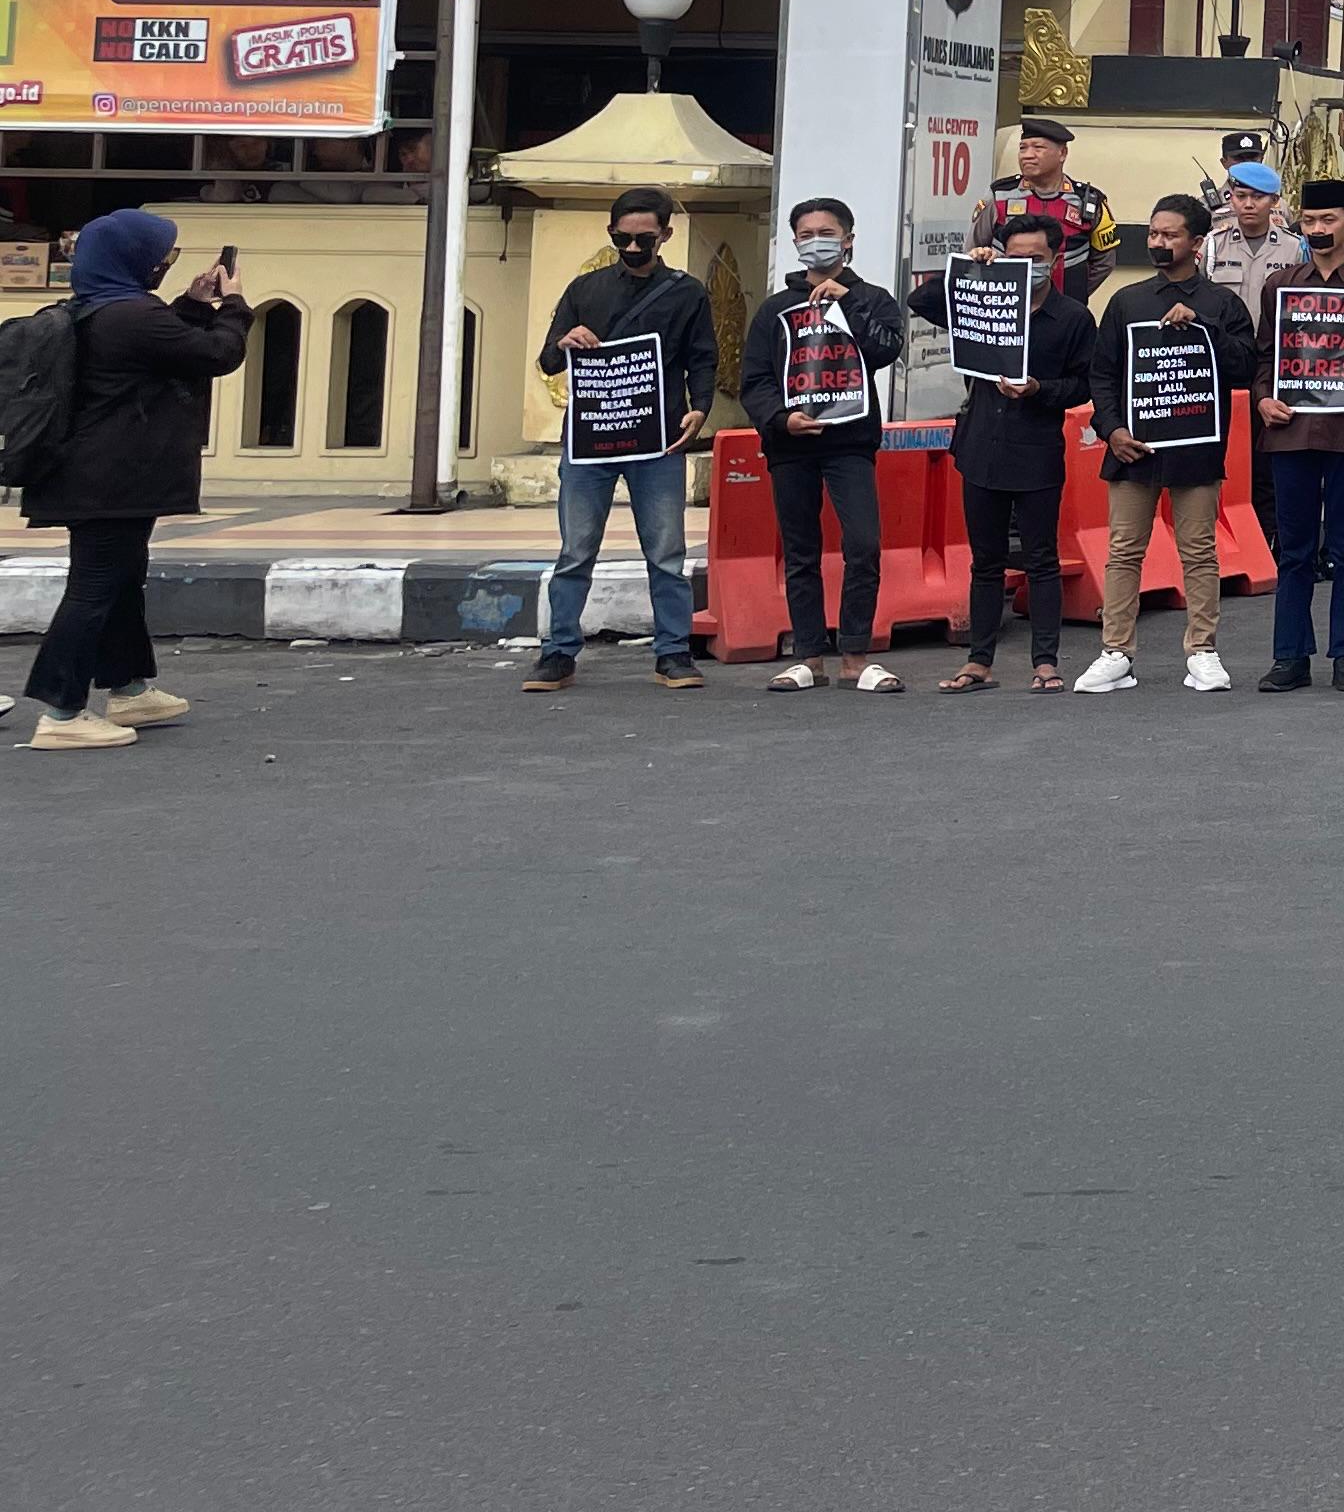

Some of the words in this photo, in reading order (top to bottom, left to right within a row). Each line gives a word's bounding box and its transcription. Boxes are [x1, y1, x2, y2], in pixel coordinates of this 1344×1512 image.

[100, 20, 132, 37] NO
[141, 21, 190, 38] KKN
[100, 42, 132, 59] NO
[139, 42, 199, 60] CALO
[242, 35, 346, 69] GRATIS
[923, 36, 948, 65] POLRES
[949, 41, 994, 71] LUMAJANG
[121, 98, 343, 117] @penerimaanpoldajatim
[928, 116, 944, 134] CALL
[945, 119, 979, 138] CENTER
[932, 140, 970, 197] 110
[956, 278, 987, 291] HITAM
[988, 281, 1017, 292] BAJU
[983, 295, 1019, 306] GELAP
[956, 304, 1017, 319] PENEGAKAN
[1292, 312, 1312, 322] BISA
[1314, 313, 1321, 322] 4
[958, 317, 990, 331] HUKUM
[992, 321, 1016, 332] BBM
[952, 328, 985, 343] SUBSIDI
[987, 334, 996, 345] DI
[791, 344, 857, 365] KENAPA
[1138, 348, 1150, 357] 03
[1152, 345, 1205, 357] NOVEMBER
[1157, 359, 1186, 369] 2025:
[788, 368, 862, 391] POLRES
[1134, 372, 1167, 382] SUDAH
[1169, 371, 1176, 380] 3
[1177, 368, 1211, 380] BULAN
[1158, 383, 1186, 393] LALU,
[1305, 380, 1321, 390] 100
[812, 393, 830, 403] 100
[1132, 397, 1152, 407] TAPI
[1154, 392, 1214, 406] TERSANGKA
[1139, 408, 1171, 419] MASIH
[894, 428, 952, 449] LUMAJANG
